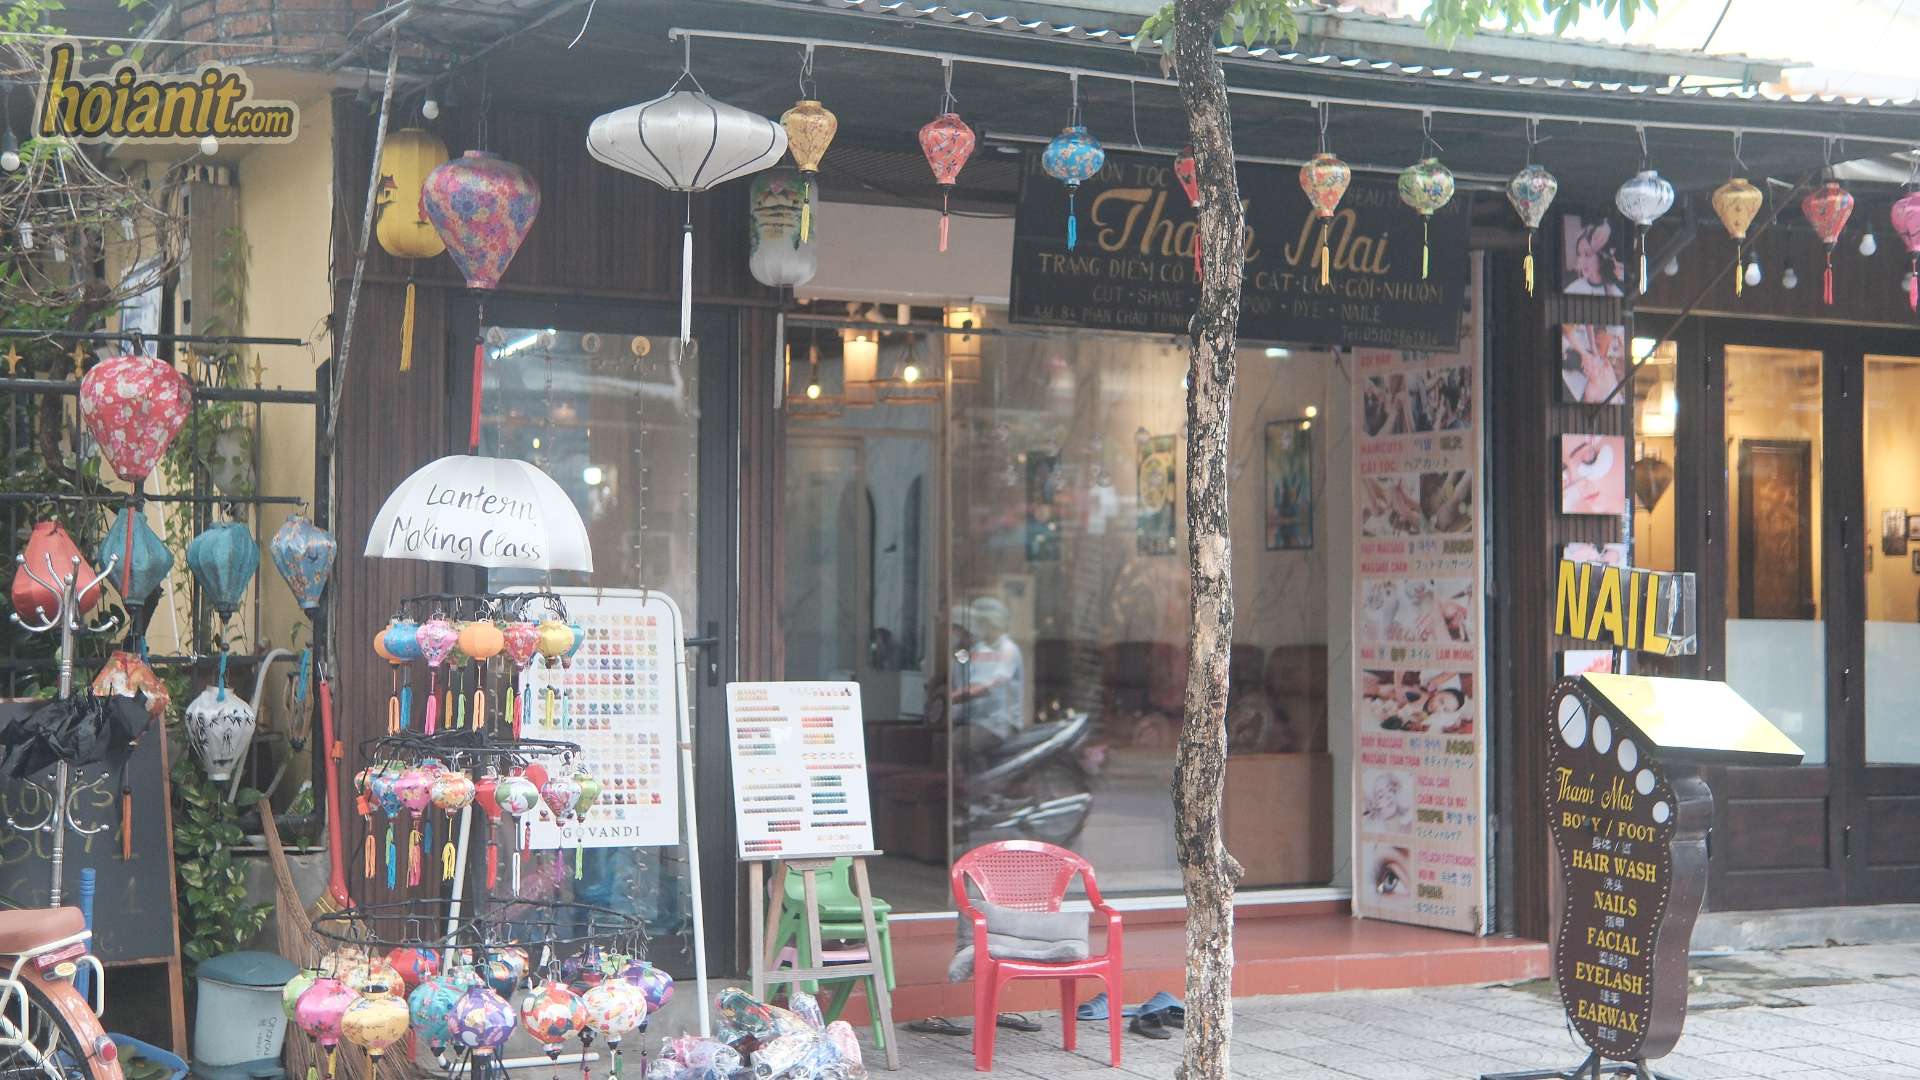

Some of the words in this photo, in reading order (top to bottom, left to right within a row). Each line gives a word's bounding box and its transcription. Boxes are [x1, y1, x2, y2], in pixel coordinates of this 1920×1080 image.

[1284, 208, 1392, 274] Mai
[1038, 253, 1100, 277] TRANG
[426, 483, 535, 520] Lantern
[389, 516, 473, 559] Making
[480, 529, 541, 560] Class
[1554, 559, 1671, 656] NAIL
[1555, 767, 1595, 806] Thanh
[1601, 776, 1635, 811] Mai
[1618, 821, 1655, 843] FOOT
[1572, 847, 1608, 873] HAIR
[1614, 857, 1657, 883] WASH
[1593, 891, 1637, 917] NAILS
[1586, 927, 1640, 956] FACIAL
[1576, 961, 1643, 995] EYELASH
[1577, 999, 1639, 1033] EARWAX
